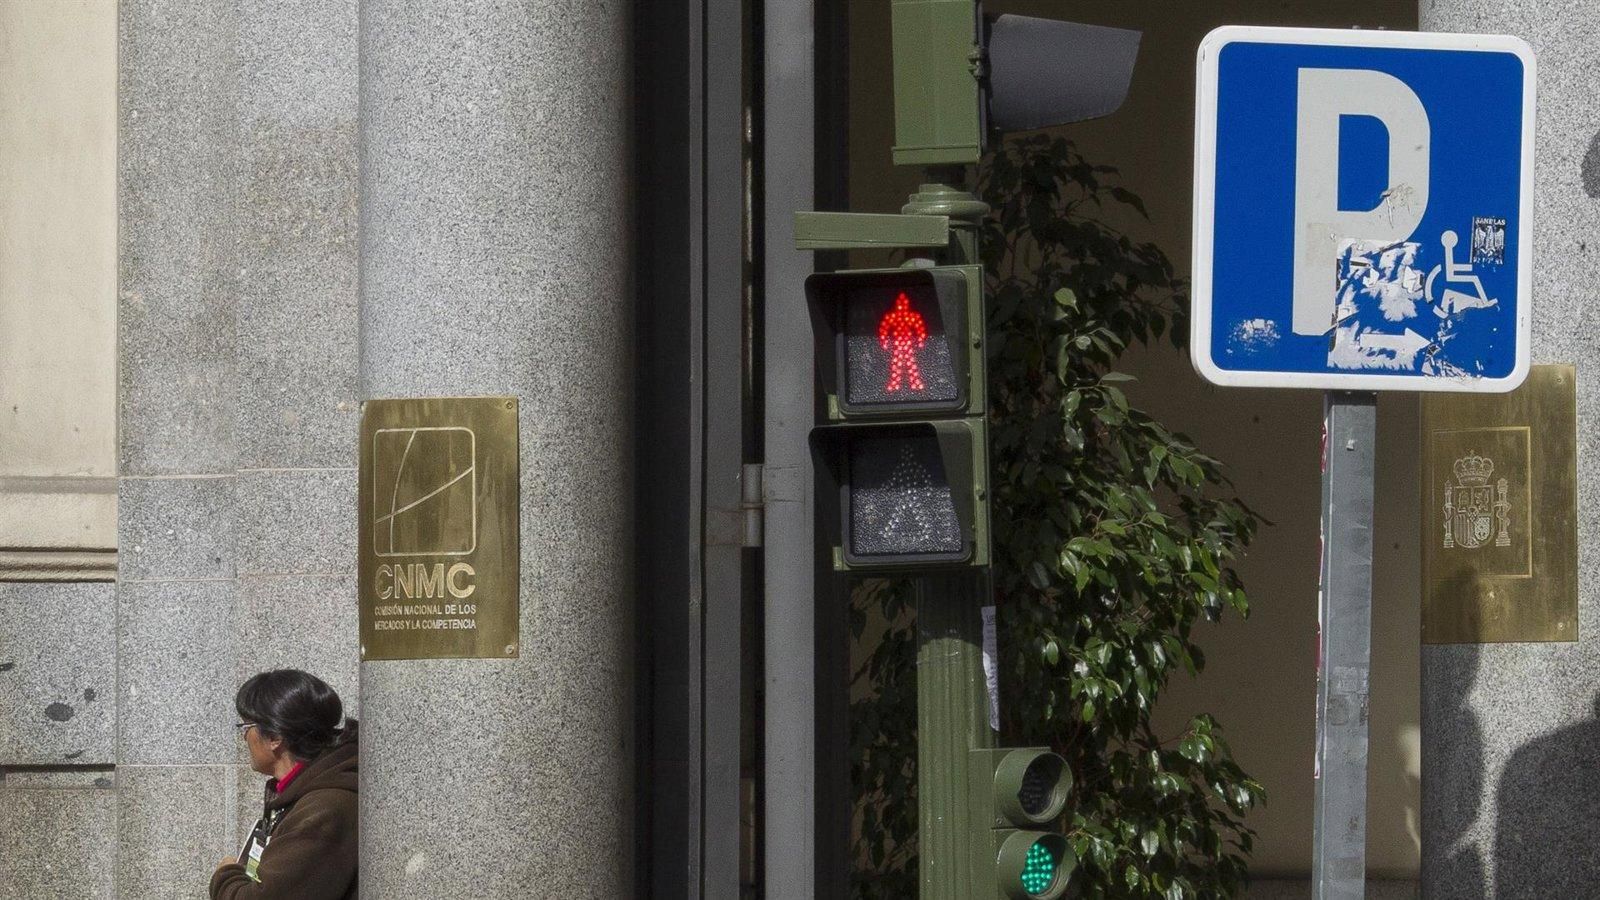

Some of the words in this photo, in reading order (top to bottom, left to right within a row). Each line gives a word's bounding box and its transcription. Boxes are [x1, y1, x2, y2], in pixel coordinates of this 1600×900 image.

[1292, 67, 1431, 336] P
[374, 562, 476, 600] CNMC
[374, 604, 402, 616] COMISIÓN
[404, 605, 442, 615] NACIONAL
[445, 604, 456, 615] DE
[459, 604, 477, 615] LOS
[374, 620, 405, 630] MERCADOS
[405, 620, 411, 630] Y
[412, 620, 421, 630] LA
[422, 619, 477, 630] COMPETENCIA
